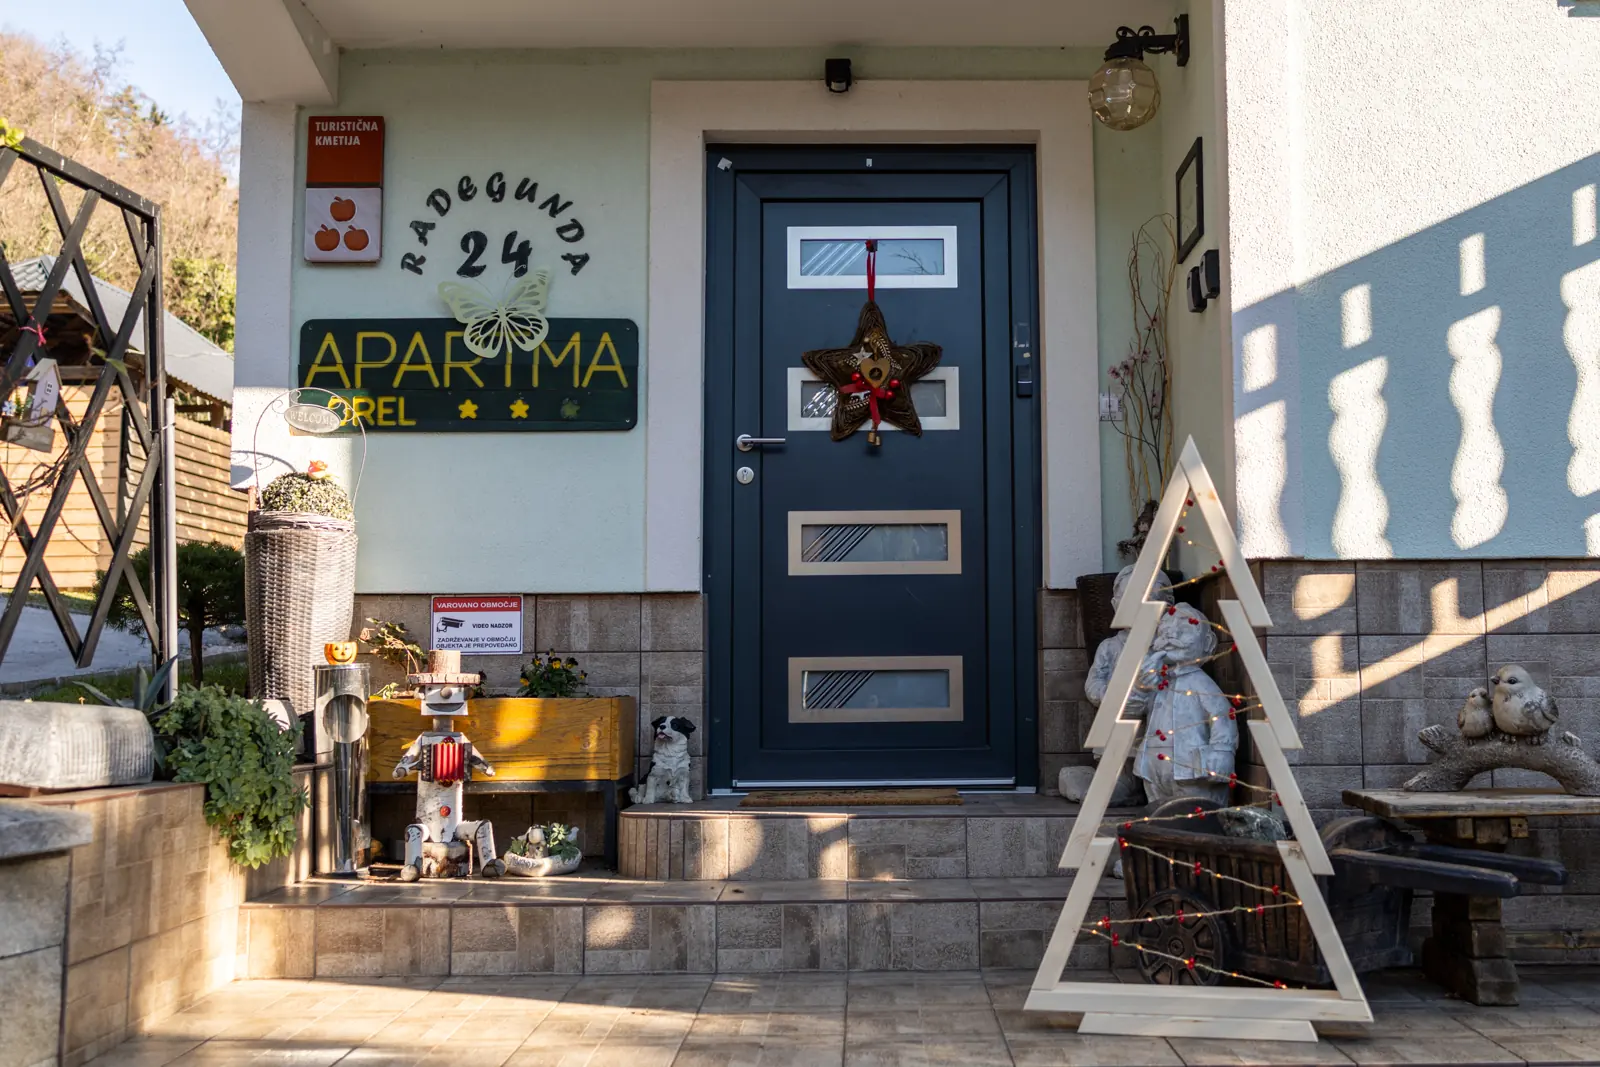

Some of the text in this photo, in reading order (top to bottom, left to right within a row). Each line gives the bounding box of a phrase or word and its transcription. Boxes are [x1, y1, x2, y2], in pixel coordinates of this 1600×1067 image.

[315, 119, 378, 131] TURISTIČNA
[315, 135, 361, 146] KMETIJA
[456, 230, 533, 278] 24
[290, 410, 334, 426] WELCOME
